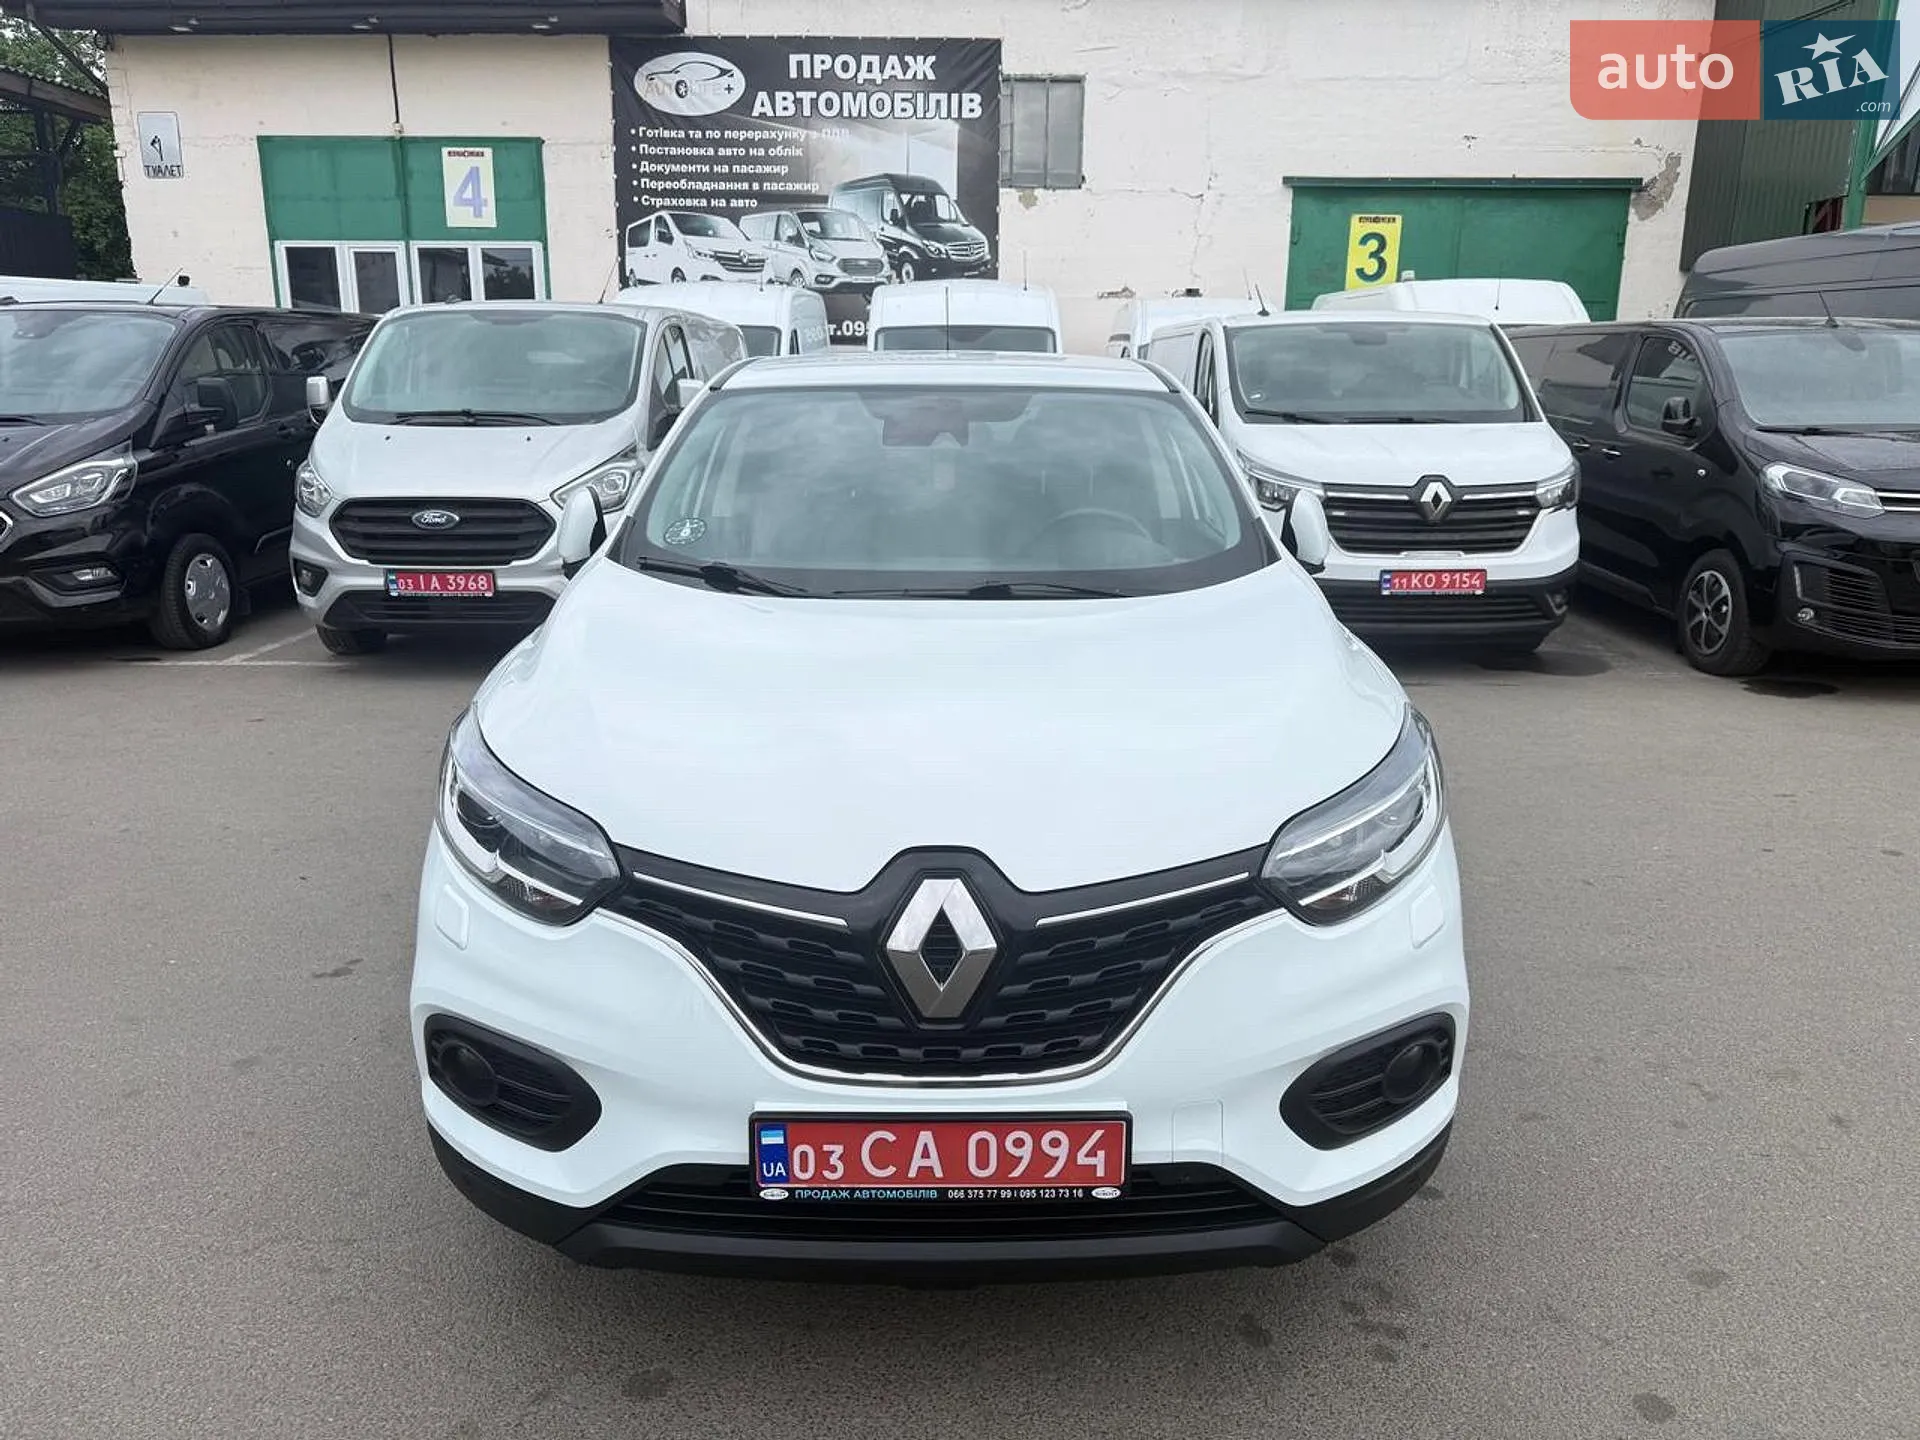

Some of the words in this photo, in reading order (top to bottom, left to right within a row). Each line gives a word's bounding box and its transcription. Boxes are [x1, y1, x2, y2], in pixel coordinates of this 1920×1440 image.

[788, 53, 937, 85] ПРОДАЖ
[751, 90, 983, 119] АВТОМОБІЛІВ
[639, 127, 685, 138] Готівка
[688, 130, 702, 139] та
[705, 130, 721, 139] по
[724, 130, 806, 142] перерахунку
[639, 144, 714, 156] Постановка
[718, 147, 746, 156] авто
[749, 147, 765, 156] на
[768, 144, 803, 157] облік
[144, 164, 182, 177] ТУАЛЕТ
[639, 161, 710, 175] Документи
[713, 164, 729, 173] на
[732, 164, 789, 176] пасажир
[453, 166, 488, 218] 4
[640, 178, 749, 192] Переобладнання
[752, 182, 760, 191] в
[763, 182, 819, 193] пасажир
[641, 195, 707, 208] Страховка
[711, 198, 727, 207] на
[730, 198, 758, 208] авто
[1355, 232, 1387, 283] 3
[827, 320, 869, 337] т.09
[398, 579, 413, 590] 03
[447, 574, 489, 590] 3968
[1393, 577, 1407, 589] 11
[1442, 573, 1481, 589] 9154
[762, 1162, 787, 1178] UA
[793, 1144, 845, 1180] 03
[860, 1130, 945, 1180] CA
[966, 1129, 1106, 1179] 0994
[795, 1189, 850, 1200] ПРОДАЖ
[853, 1189, 938, 1199] АВТОМОБІЛІВ
[948, 1189, 965, 1199] 066
[967, 1189, 985, 1199] 375
[986, 1189, 998, 1199] 77
[1000, 1189, 1013, 1199] 99
[1019, 1189, 1037, 1199] 095
[1039, 1189, 1056, 1199] 123
[1058, 1189, 1070, 1199] 73
